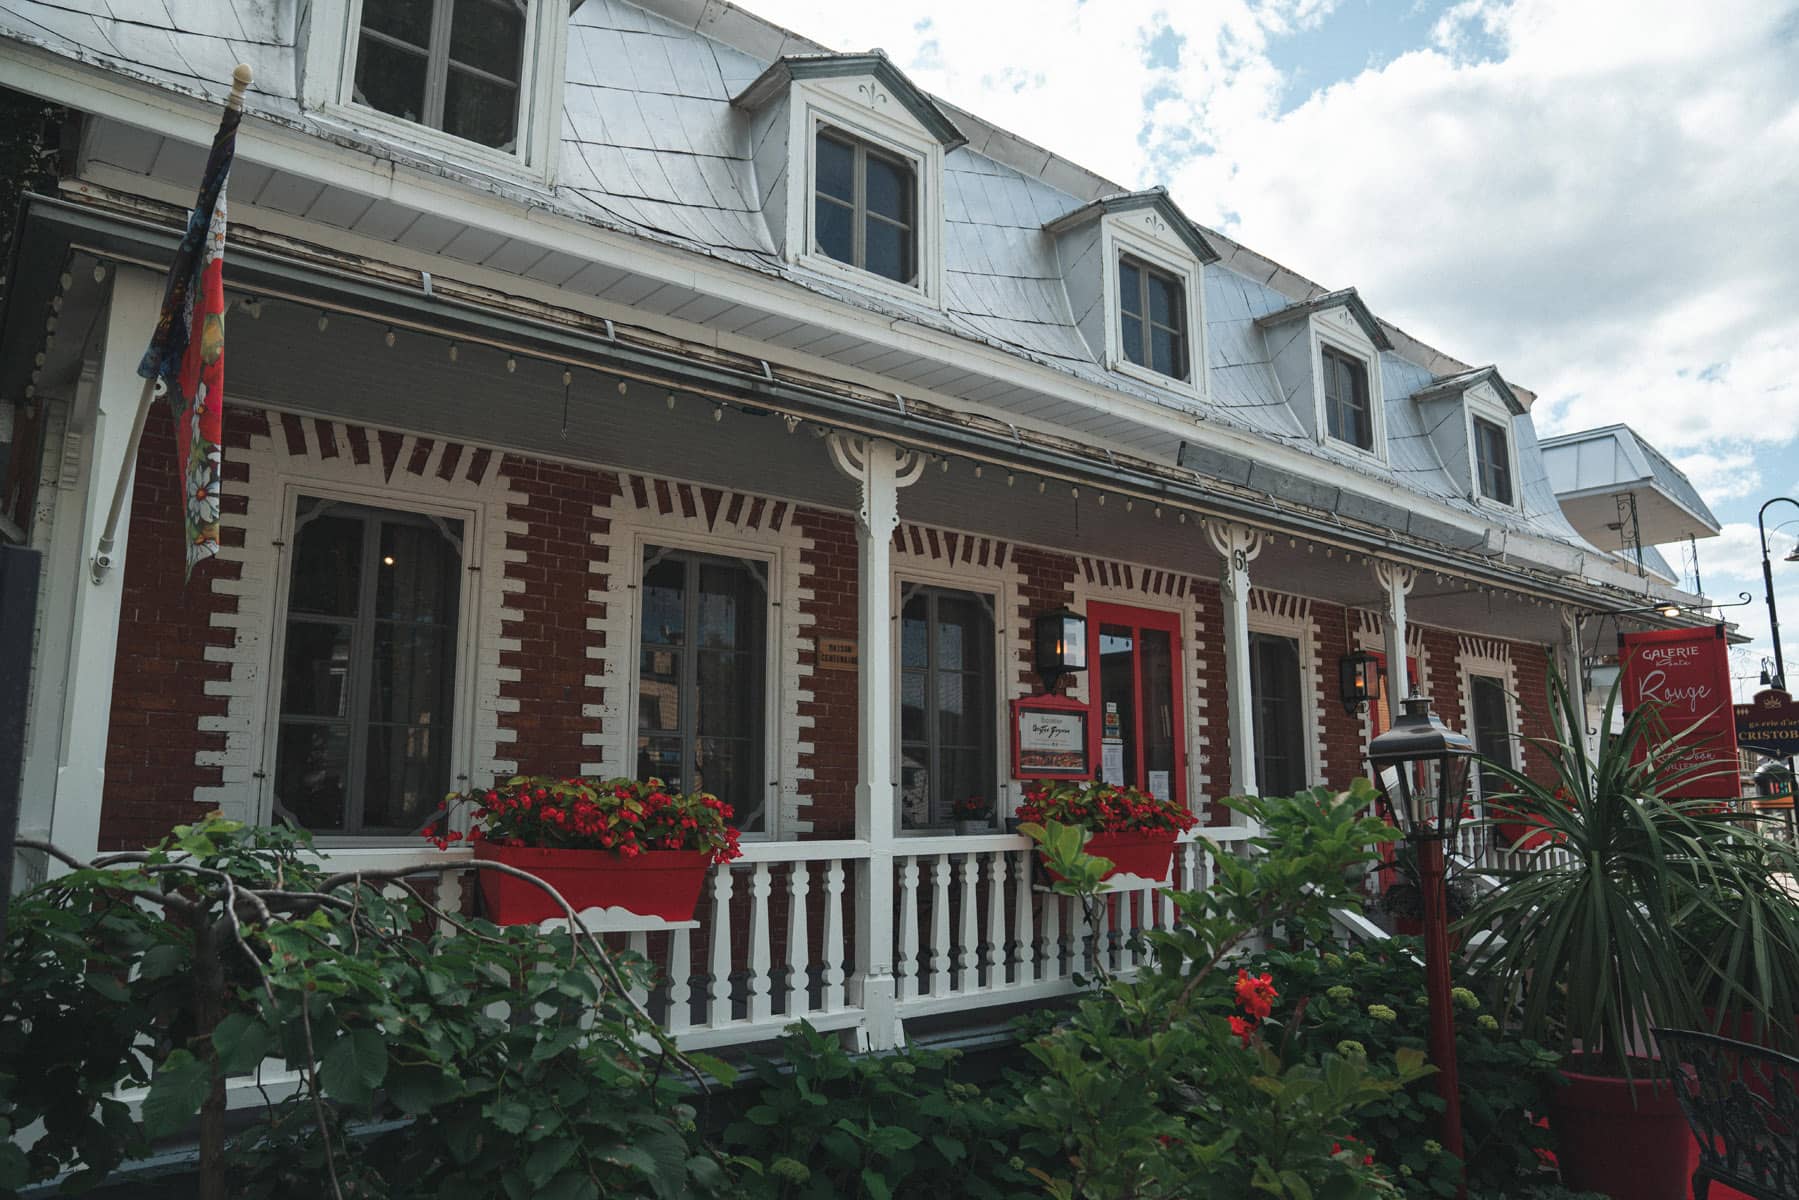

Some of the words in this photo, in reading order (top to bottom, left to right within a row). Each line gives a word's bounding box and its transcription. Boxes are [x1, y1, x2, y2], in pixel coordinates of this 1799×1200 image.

[1234, 549, 1247, 573] 61
[1642, 646, 1700, 661] GALERIE
[1638, 670, 1712, 713] Rouge
